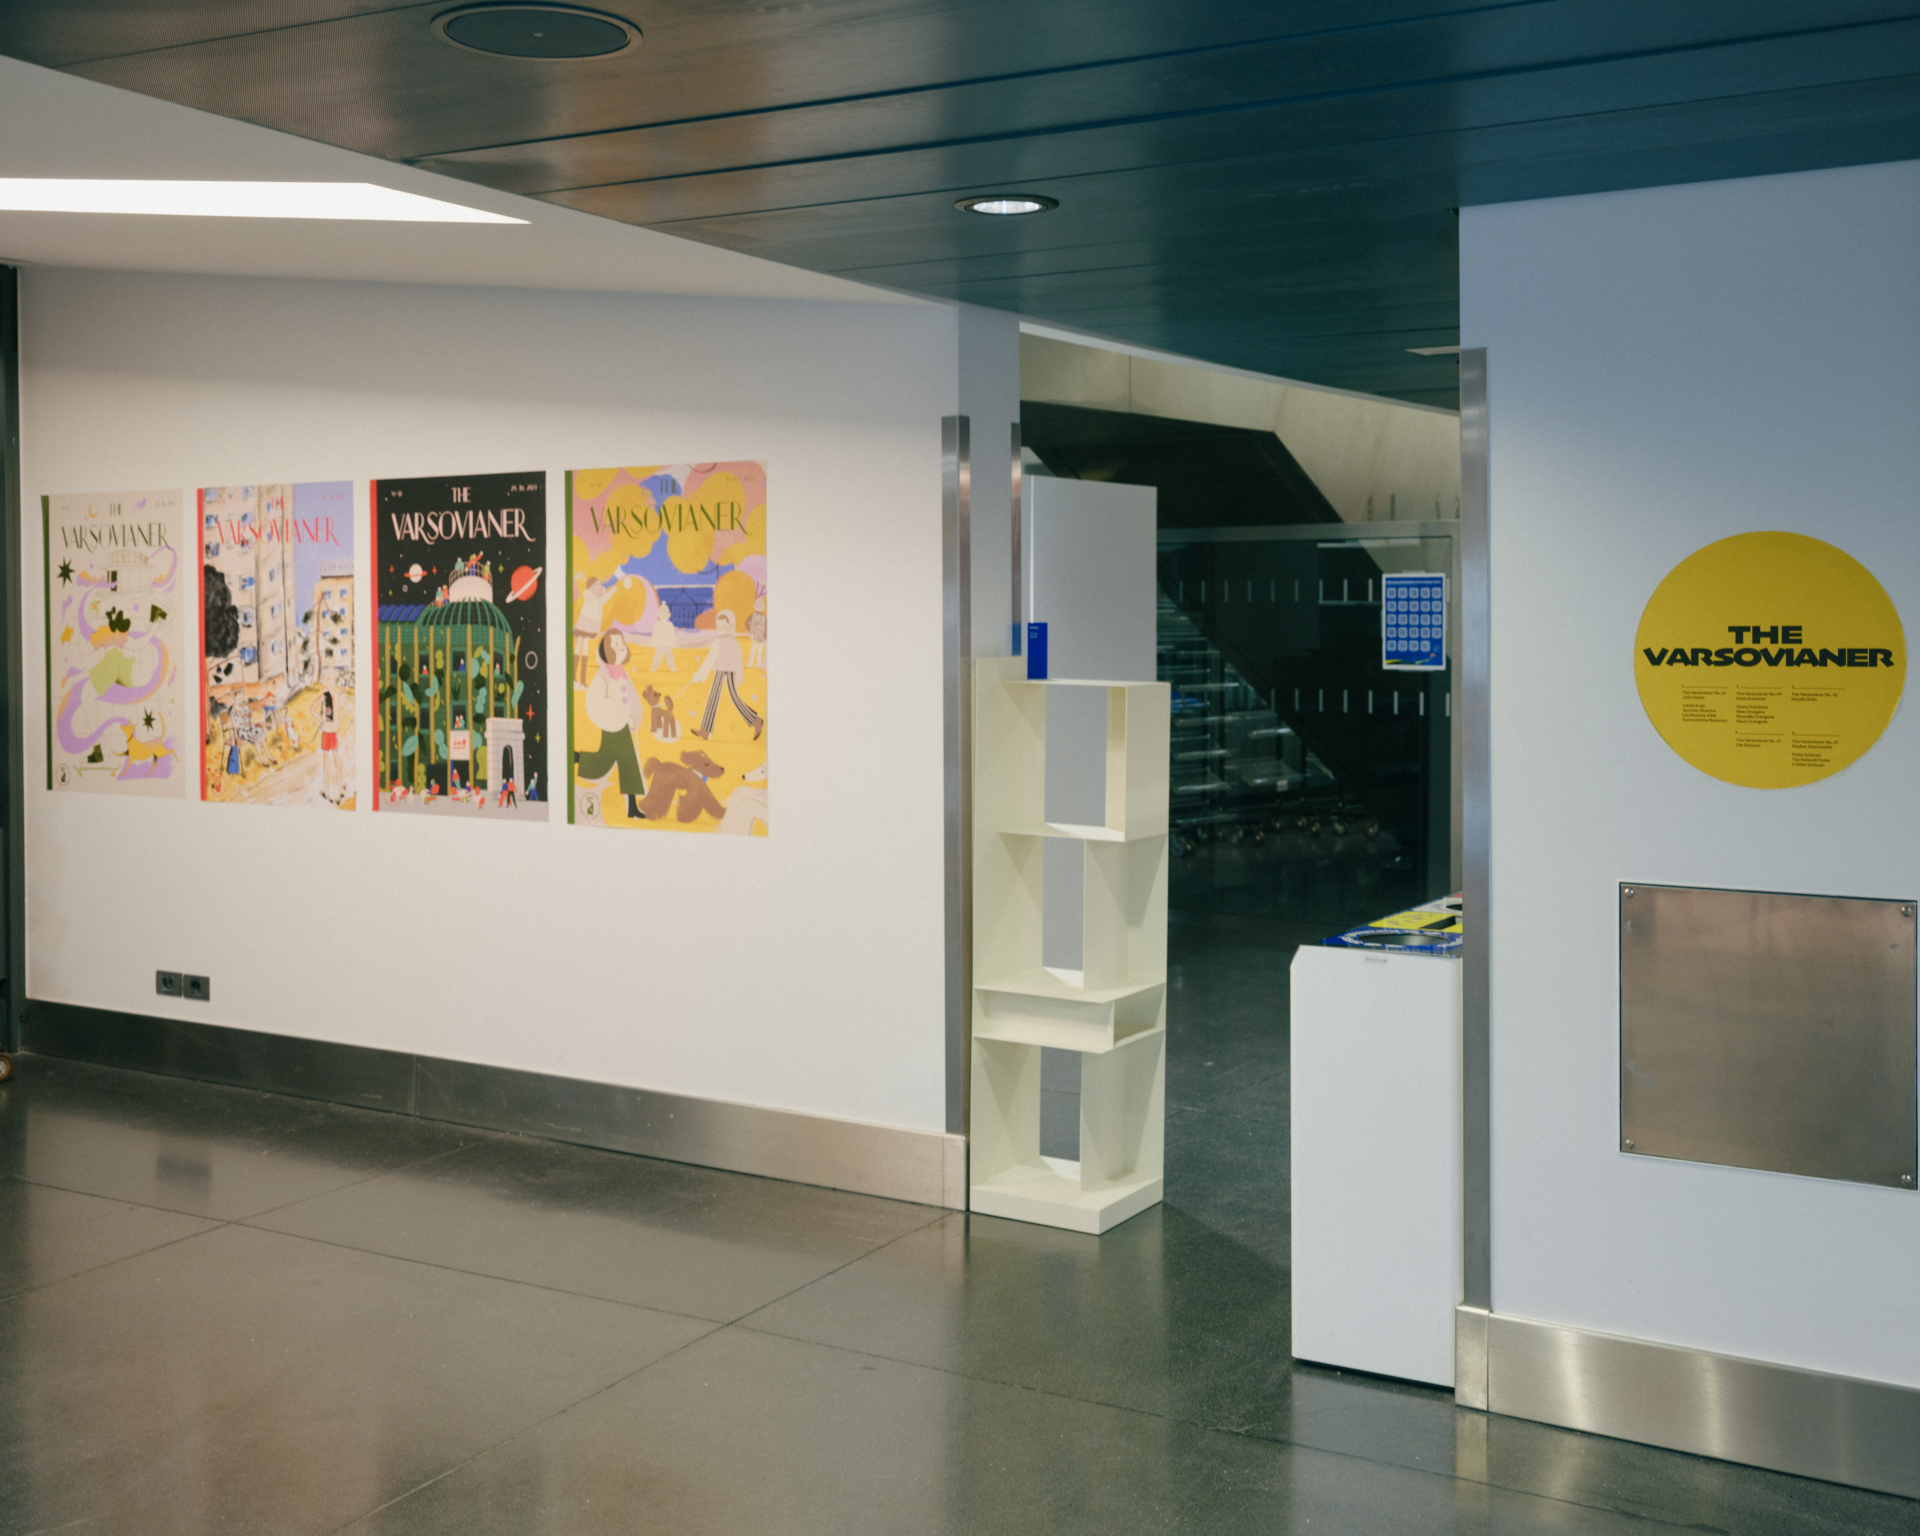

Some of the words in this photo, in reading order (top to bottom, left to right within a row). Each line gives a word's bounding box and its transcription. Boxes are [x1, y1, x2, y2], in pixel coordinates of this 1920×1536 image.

[451, 486, 472, 503] THE
[217, 516, 344, 549] VARSOVIANER
[391, 508, 536, 546] VARSOVIANER
[590, 502, 755, 539] VARSOVIANER
[61, 522, 171, 554] VARSOVIANER
[1728, 626, 1802, 644] THE
[1644, 647, 1895, 668] VARSOVIANER
